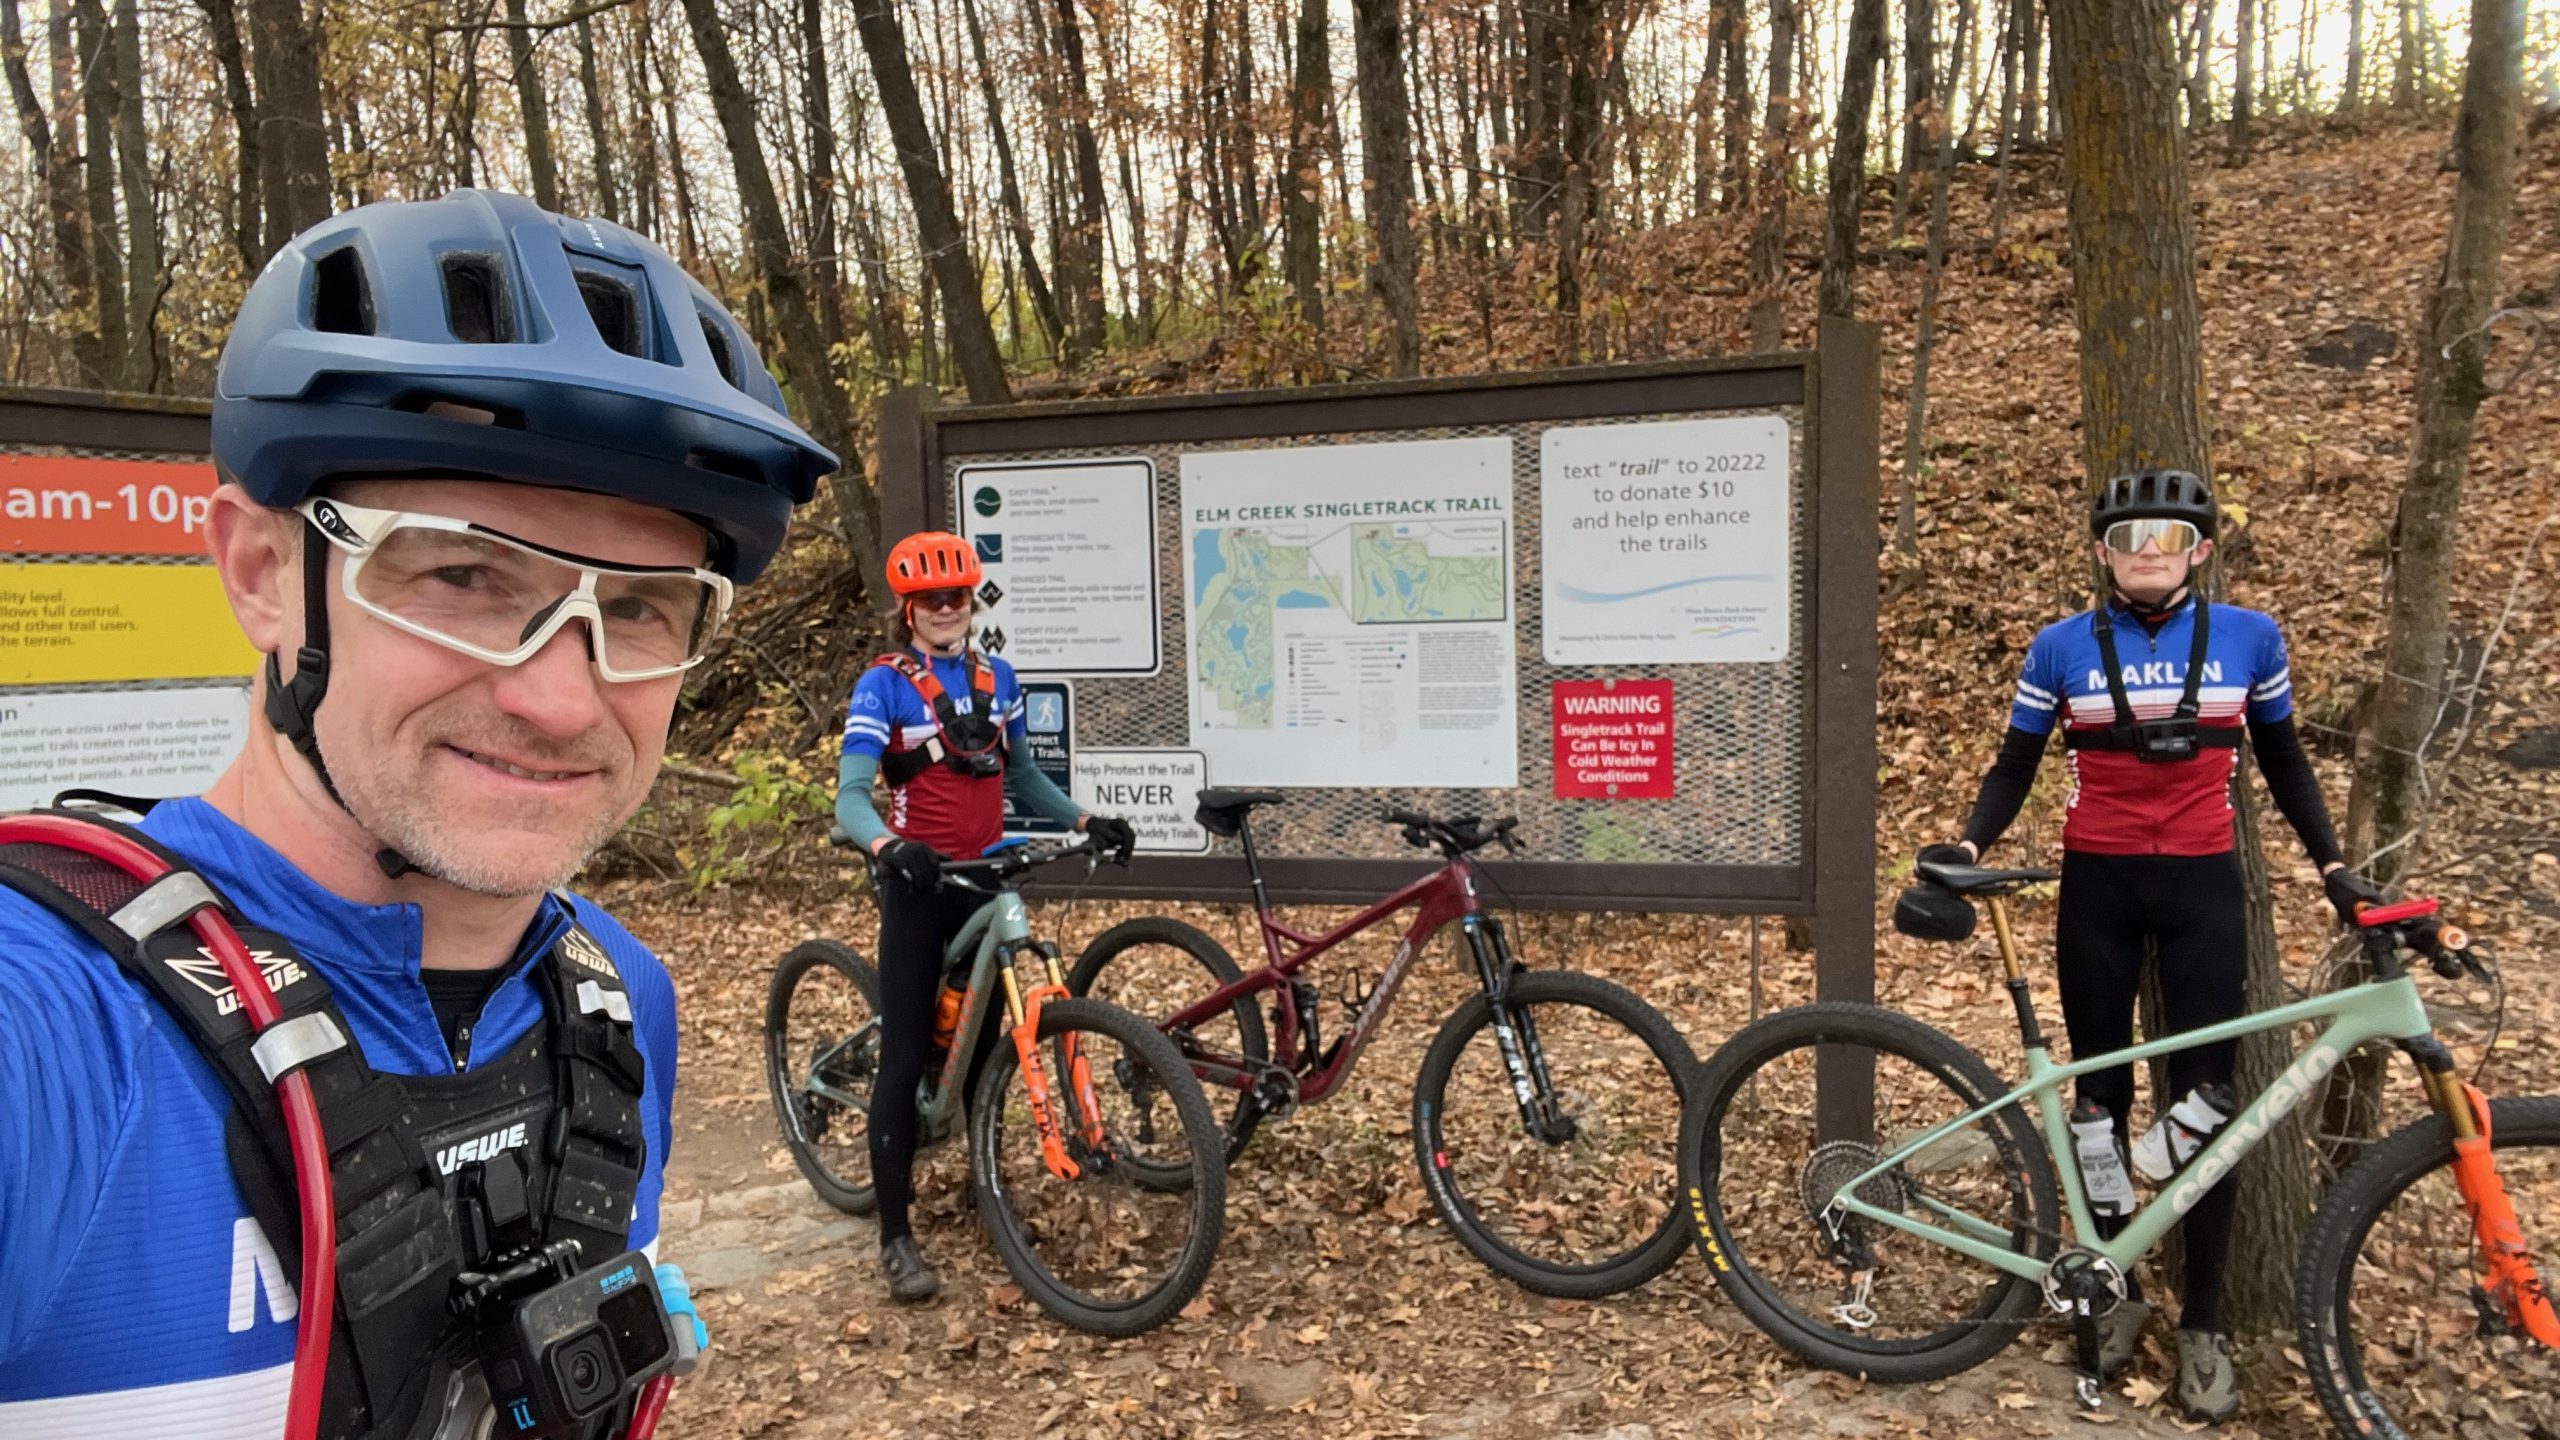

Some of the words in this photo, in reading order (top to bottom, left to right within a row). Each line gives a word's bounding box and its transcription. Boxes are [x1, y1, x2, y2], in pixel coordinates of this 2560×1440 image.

[1563, 464, 1601, 479] text
[1678, 459, 1698, 474] to
[1705, 454, 1766, 473] 20222
[1594, 488, 1614, 502] to
[1620, 485, 1691, 502] donate
[1699, 481, 1734, 500] $10
[1195, 509, 1230, 522] ELM
[1238, 506, 1296, 520] CREEK
[1303, 500, 1436, 519] SINGLETRACK
[1445, 497, 1503, 512] TRAIL
[1572, 511, 1608, 529] and
[1615, 509, 1658, 531] help
[1665, 508, 1750, 526] enhance
[1620, 536, 1652, 552] the
[1658, 533, 1707, 551] trails
[43, 605, 65, 617] full
[69, 604, 123, 617] control.
[25, 620, 63, 632] other
[69, 619, 96, 632] trail
[2089, 660, 2223, 691] MAKLN
[1564, 695, 1661, 715] WARNING
[1560, 722, 1633, 739] Singletrack
[1636, 721, 1666, 736] Trail
[1026, 735, 1059, 746] rotect
[1570, 739, 1597, 752] Can
[1600, 738, 1617, 752] Be
[1620, 739, 1638, 754] Icy
[1641, 739, 1655, 752] In
[1037, 747, 1069, 759] Trails.
[1568, 754, 1599, 768] Cold
[1601, 753, 1658, 768] Weather
[1075, 764, 1102, 776] Help
[1104, 763, 1145, 775] Protect
[1148, 763, 1168, 775] the
[1171, 763, 1195, 775] Trail
[1577, 770, 1649, 783] Conditions
[1096, 784, 1174, 805] NEVER
[1142, 814, 1153, 823] or
[1171, 828, 1199, 839] Trails
